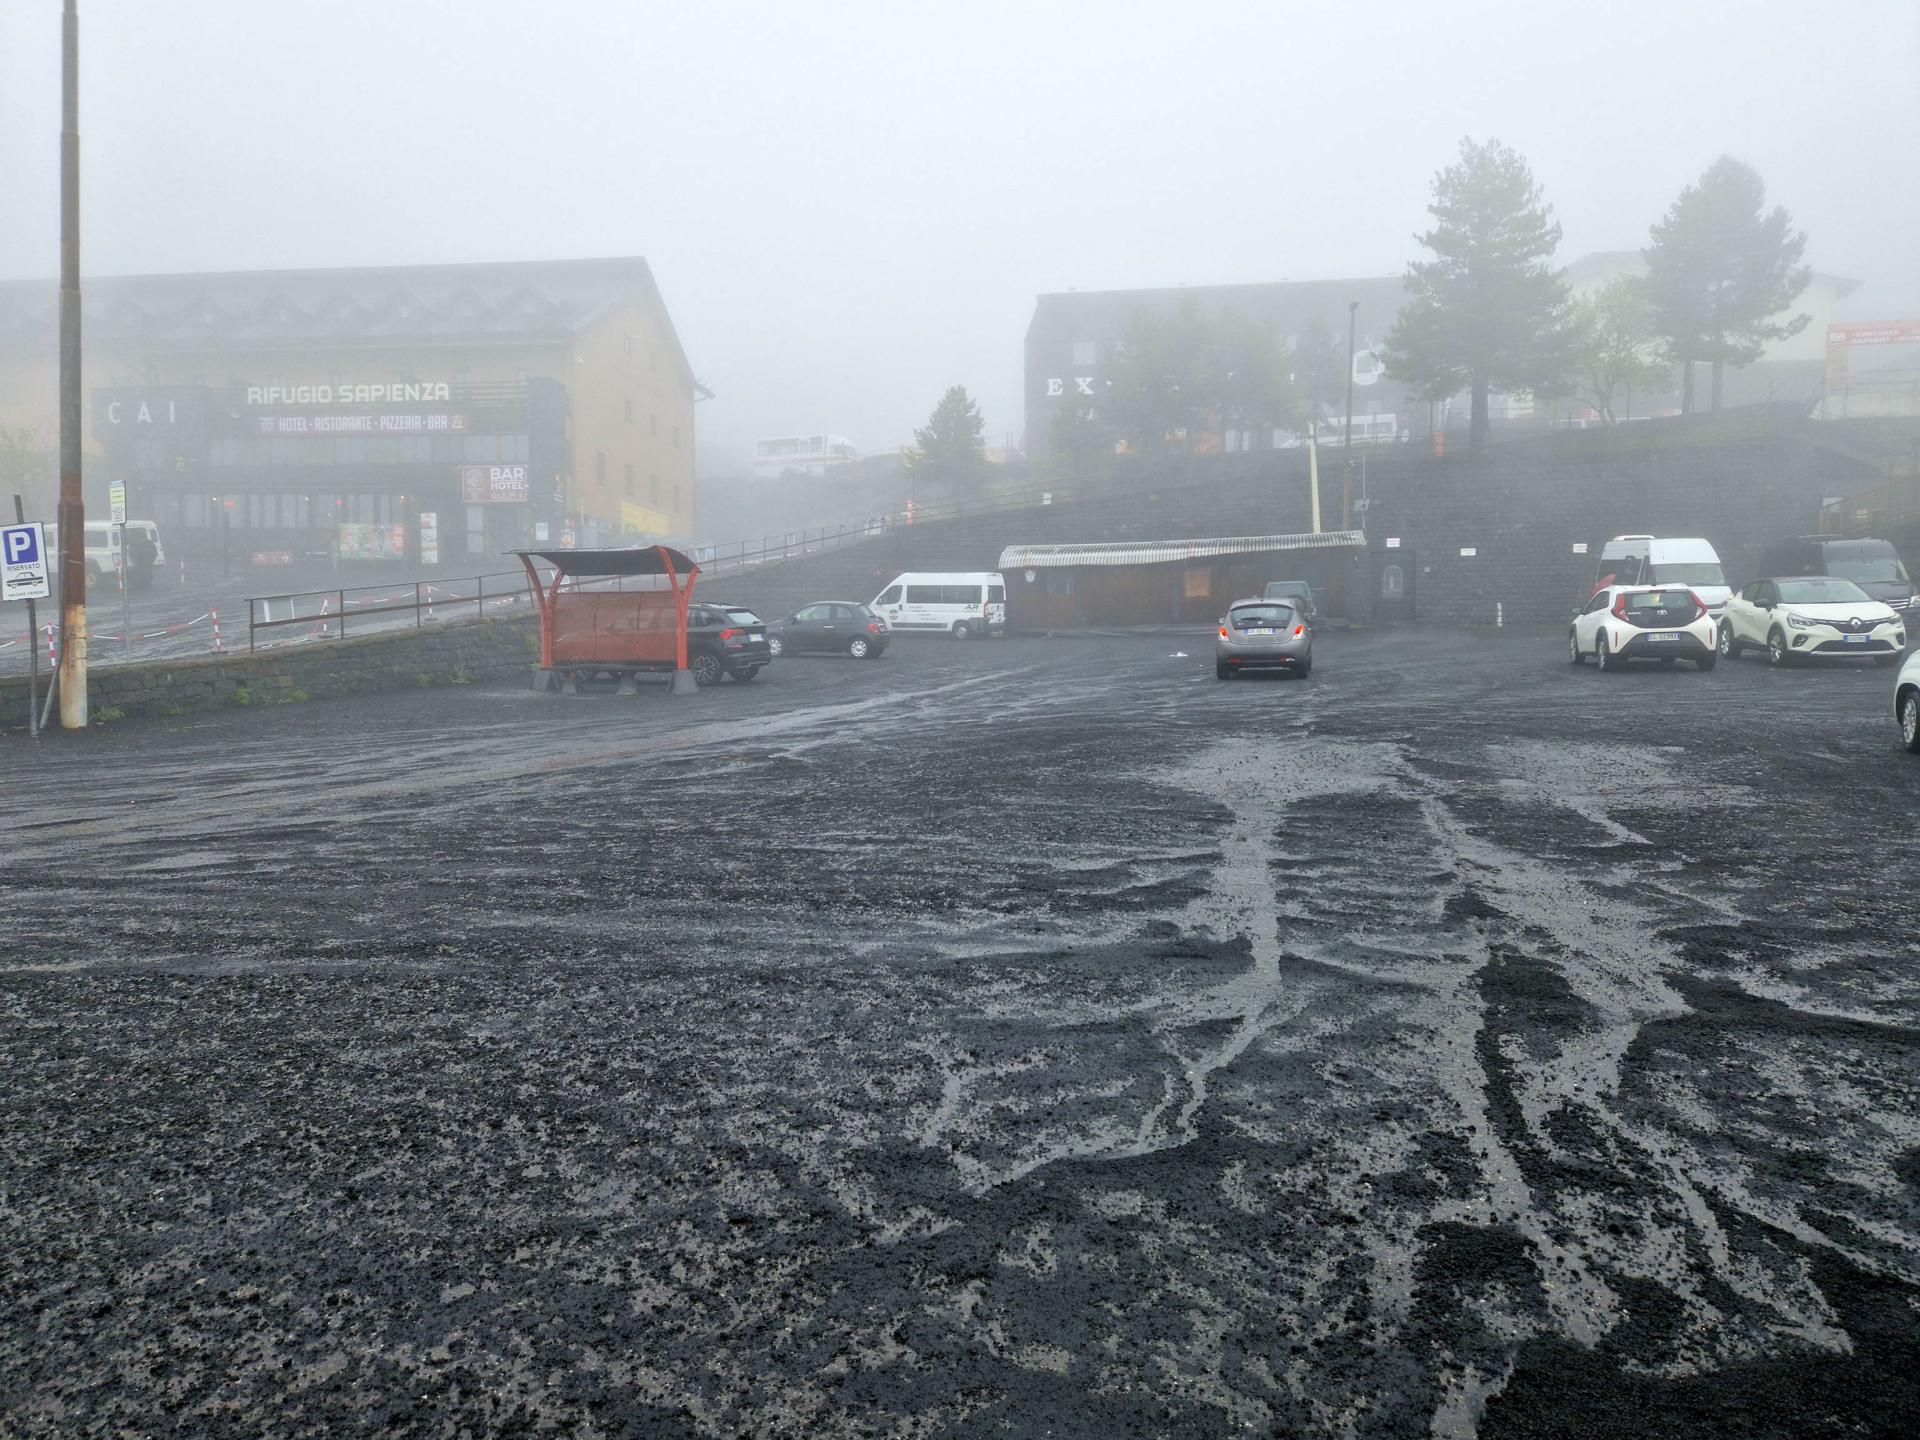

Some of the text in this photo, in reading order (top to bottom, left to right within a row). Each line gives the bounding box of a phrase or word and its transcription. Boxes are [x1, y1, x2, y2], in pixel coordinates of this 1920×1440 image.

[248, 383, 449, 404] RIFUGIO SAPIENZA
[279, 415, 448, 431] HOTEL RISTORANTE PIZZERIA BAR
[490, 467, 524, 480] BAR
[490, 481, 525, 491] HOTEL
[8, 531, 31, 562] P
[7, 562, 40, 571] RISERVATO
